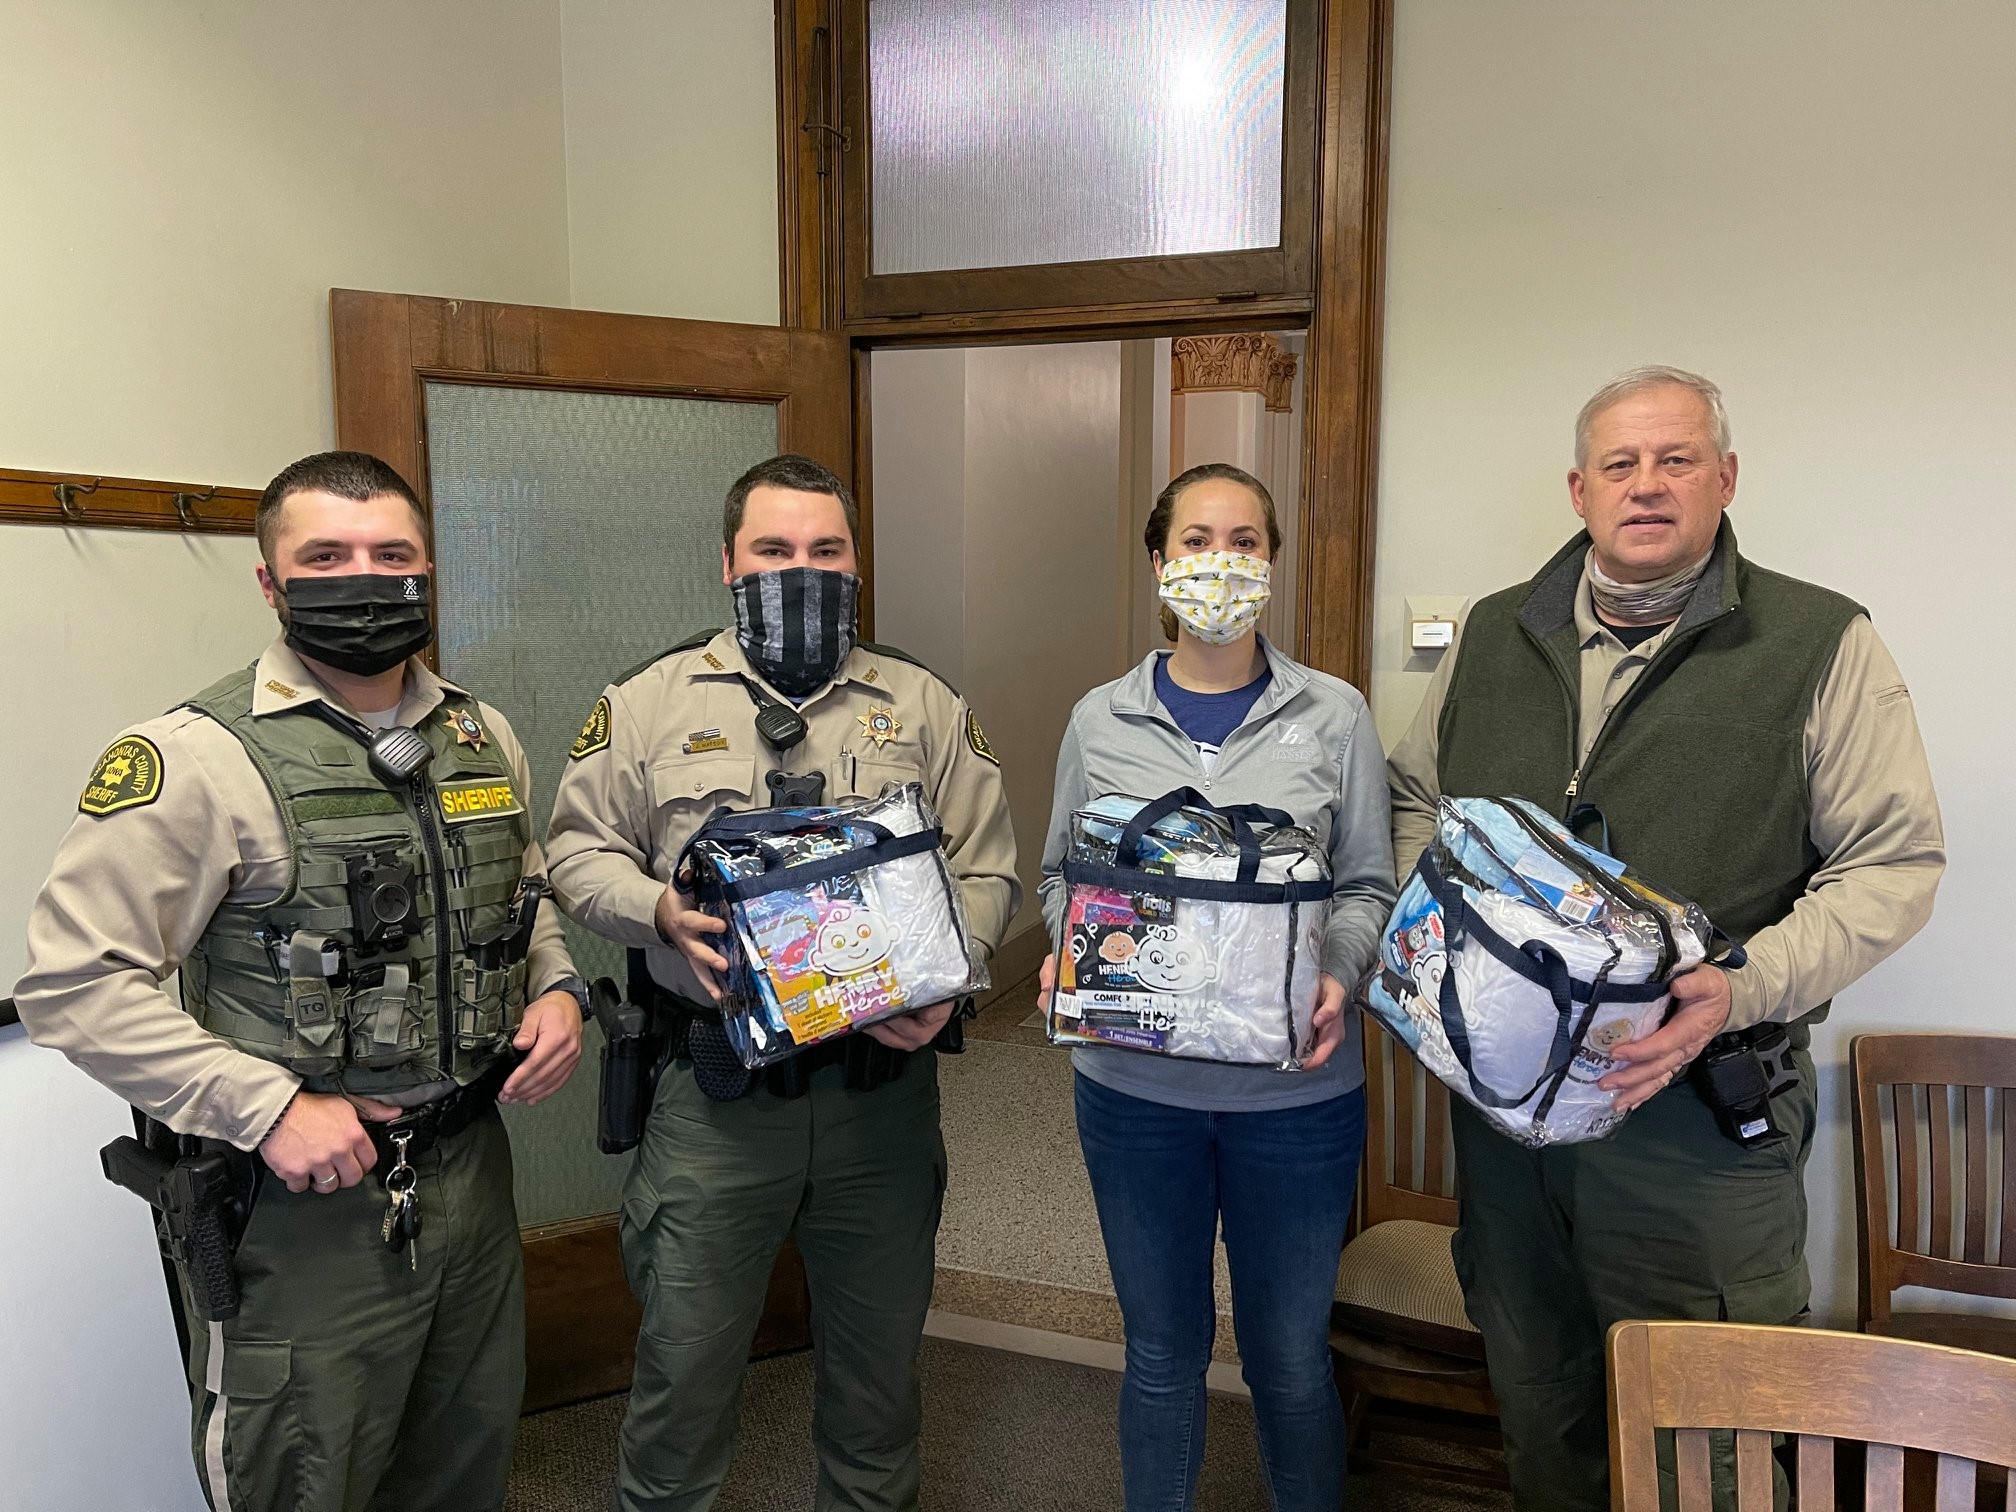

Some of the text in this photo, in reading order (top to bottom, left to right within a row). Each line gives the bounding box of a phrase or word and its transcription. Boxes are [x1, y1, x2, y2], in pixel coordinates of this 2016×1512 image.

[131, 755, 149, 794] COUNTY
[441, 786, 513, 814] SHERIFF
[299, 1001, 325, 1016] TQ
[838, 983, 912, 1017] Heroes
[1137, 1007, 1214, 1039] Heroes
[1578, 1046, 1616, 1070] ENRY'S
